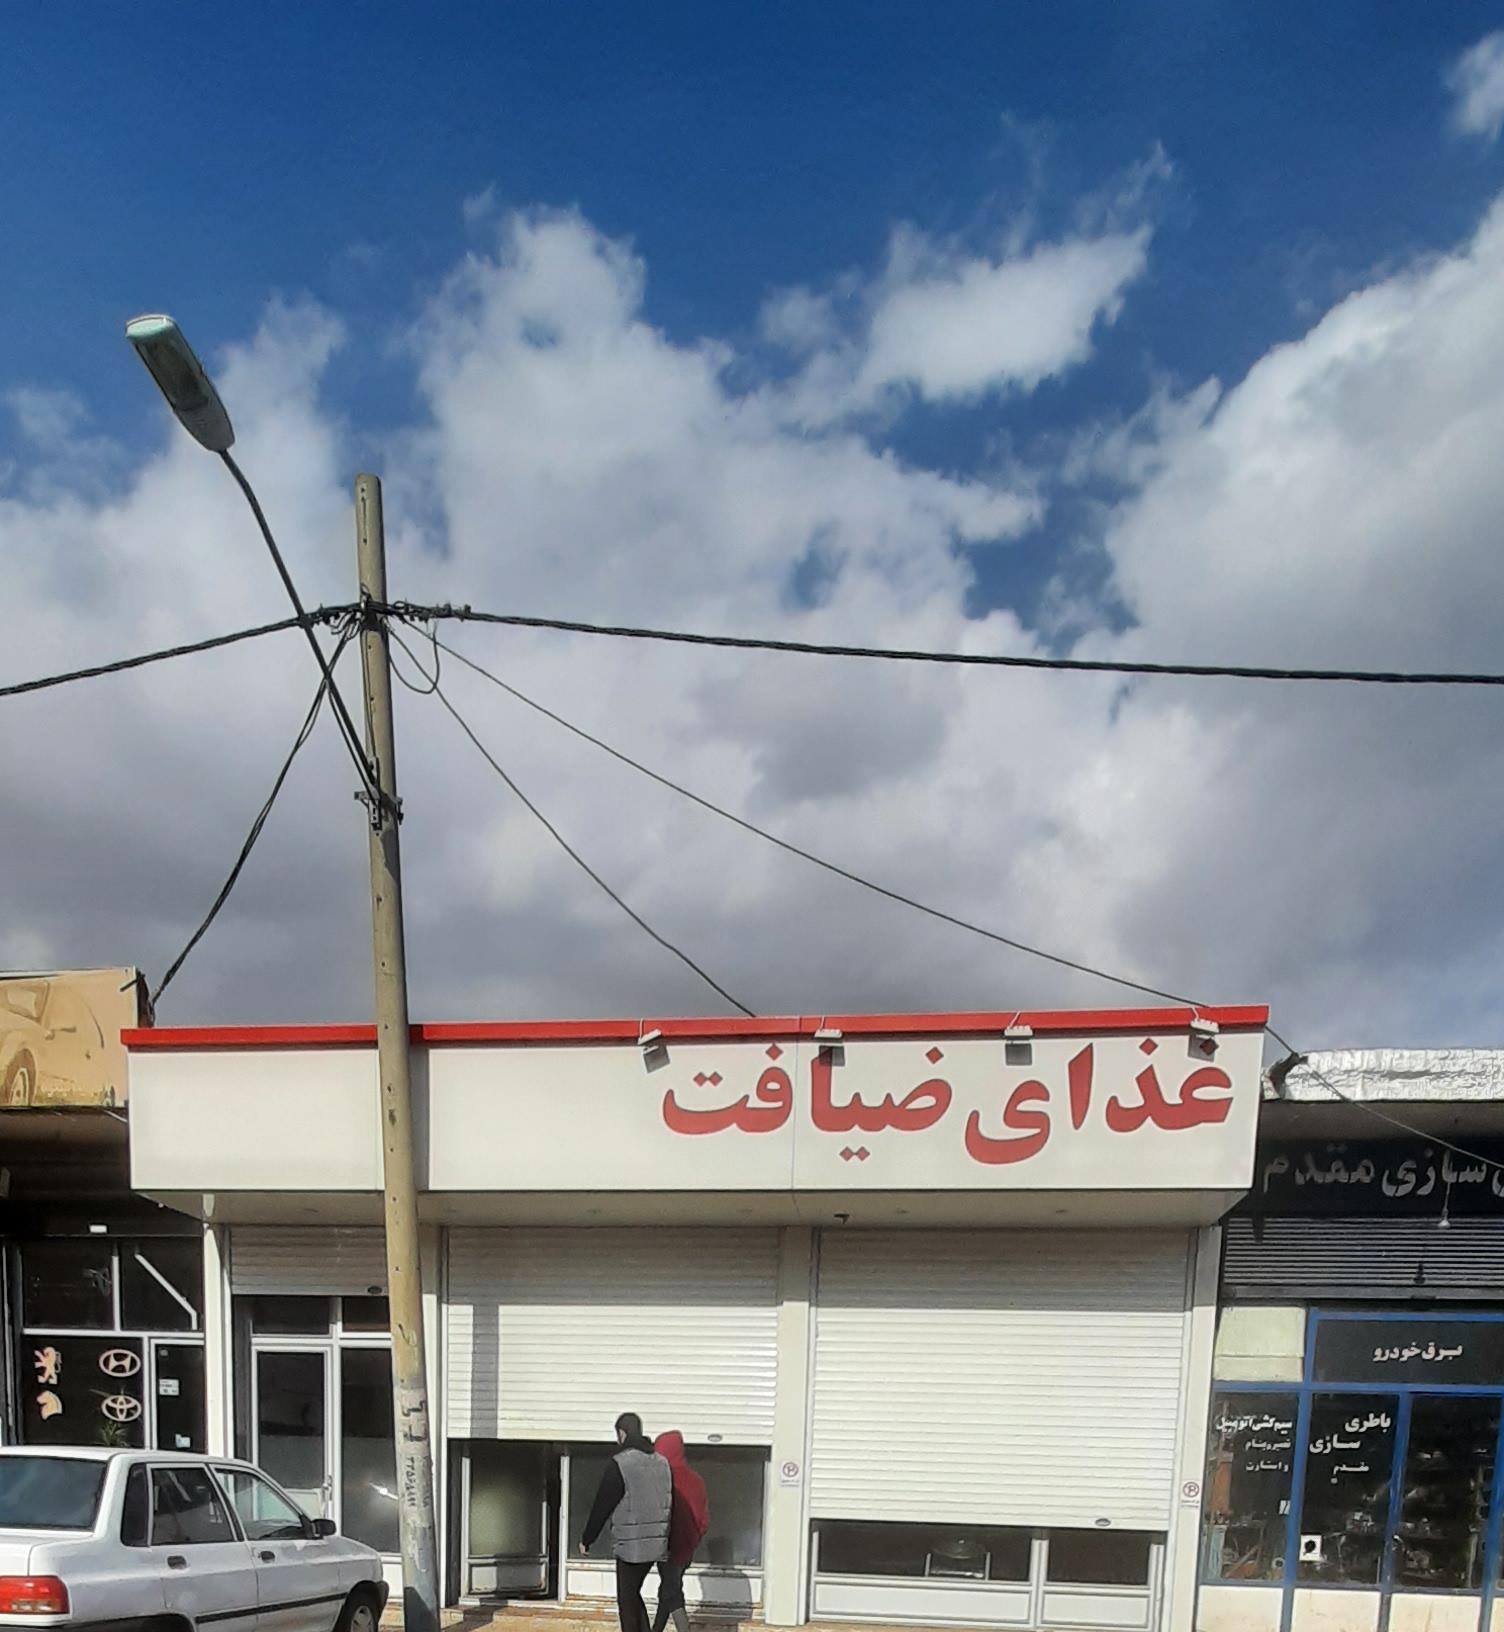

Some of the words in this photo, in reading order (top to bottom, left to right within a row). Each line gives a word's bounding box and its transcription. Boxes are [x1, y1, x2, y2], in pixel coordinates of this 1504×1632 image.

[662, 1043, 954, 1163] ضیافت
[965, 1036, 1235, 1165] غذای
[1263, 1144, 1376, 1193] مقدم
[1382, 1148, 1488, 1197] سازی
[1373, 1342, 1421, 1362] خودرو
[1421, 1342, 1463, 1361] برق
[1344, 1412, 1392, 1434] باطری
[1309, 1433, 1361, 1454] سازی
